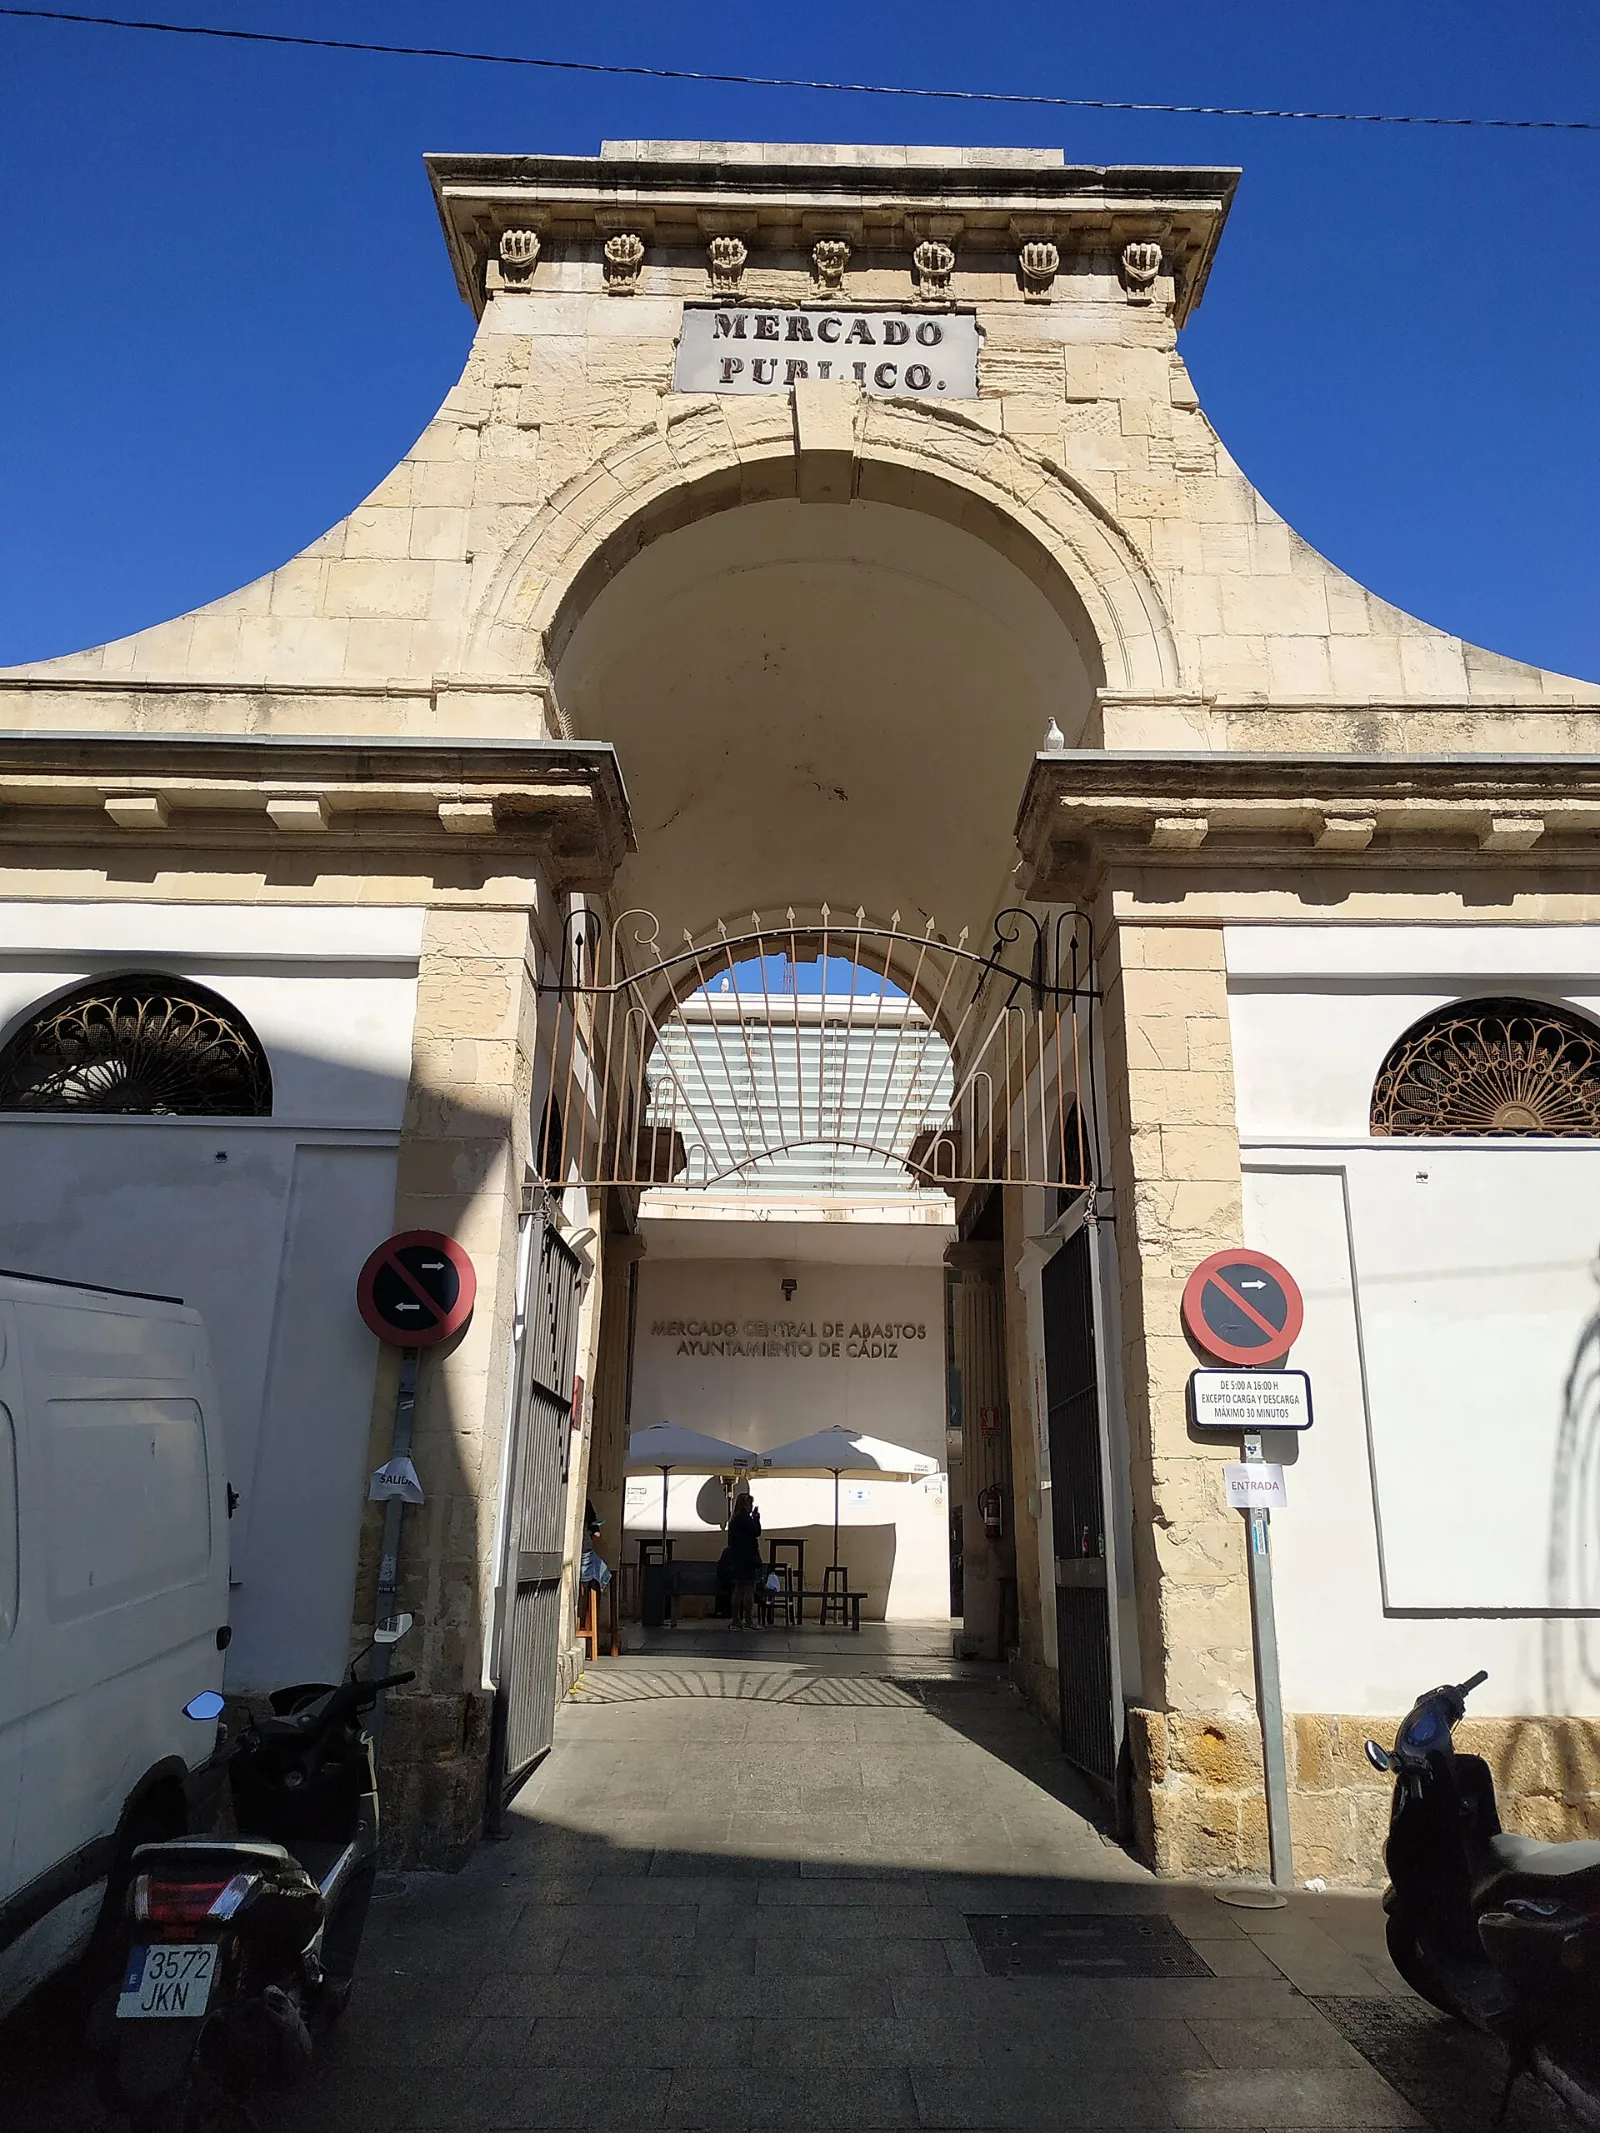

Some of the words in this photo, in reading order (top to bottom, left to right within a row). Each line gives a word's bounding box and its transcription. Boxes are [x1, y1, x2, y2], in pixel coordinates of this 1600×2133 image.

[712, 313, 945, 346] MERCADO
[650, 1320, 738, 1337] MERCADO
[744, 1321, 817, 1338] CENTRAL
[823, 1323, 844, 1338] DE
[848, 1323, 927, 1340] ABASTOS
[676, 1340, 813, 1357] AYUNTAMIENTO
[818, 1342, 841, 1358] DE
[846, 1339, 899, 1359] CÁDIZ
[1220, 1380, 1230, 1390] DE
[1231, 1381, 1246, 1390] 5:00
[1246, 1381, 1253, 1390] A
[1254, 1381, 1272, 1390] 16:00
[1273, 1381, 1279, 1390] H
[1201, 1394, 1231, 1404] EXCEPTO
[1232, 1394, 1257, 1404] CARGA
[1257, 1395, 1262, 1404] Y
[1263, 1394, 1300, 1405] DESCARGA
[1214, 1406, 1245, 1418] MÁXIMO
[1246, 1408, 1255, 1418] 30
[1256, 1408, 1289, 1419] MINUTOS
[1231, 1481, 1280, 1491] ENTRADA
[149, 1950, 211, 1980] 3572
[129, 1973, 138, 1984] E
[141, 1982, 190, 2011] JKN
